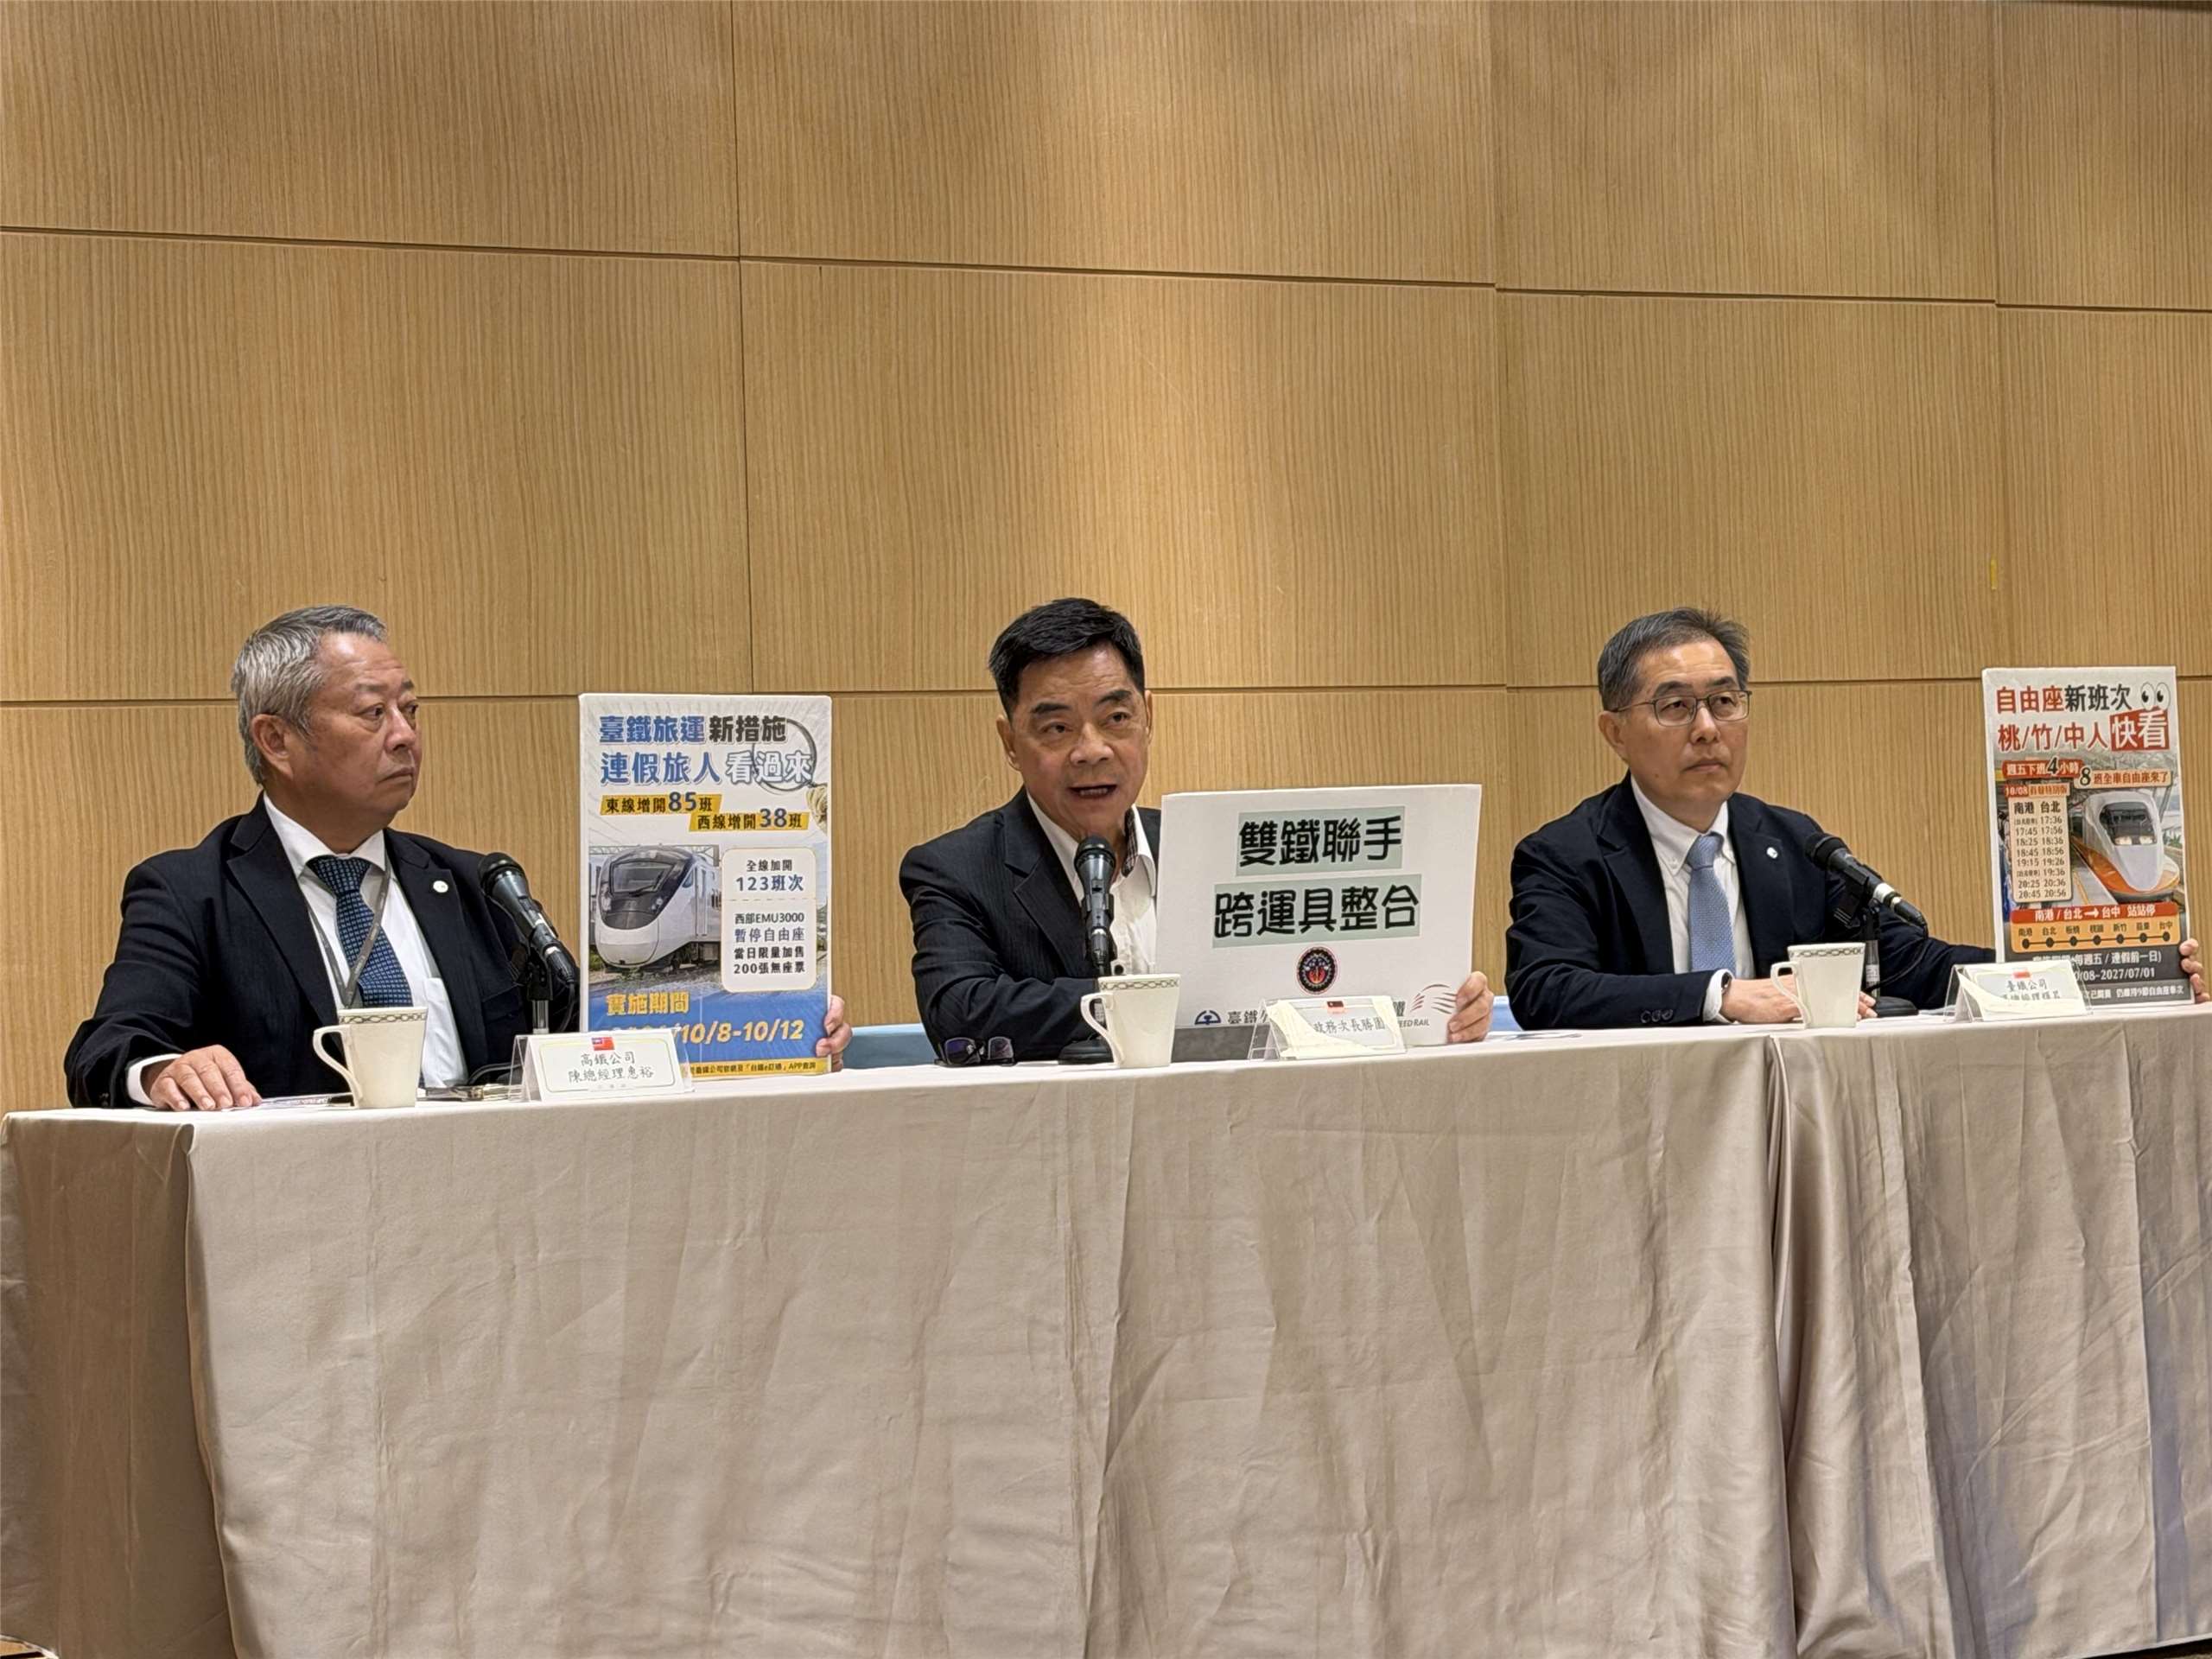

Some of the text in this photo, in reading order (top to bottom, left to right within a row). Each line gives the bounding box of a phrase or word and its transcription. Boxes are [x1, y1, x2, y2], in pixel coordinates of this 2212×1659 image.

[1997, 683, 2132, 714] 自由座新班次
[600, 750, 814, 785] 連假旅人看過來
[606, 791, 713, 813] 東線增開85班
[2040, 800, 2062, 813] 台北
[697, 809, 802, 830] 西線增開38班
[1239, 815, 1402, 868] 雙鐵聯手
[747, 859, 792, 873] 全線加開
[735, 874, 804, 892] 123班次
[734, 912, 805, 925] 西部EMU3000
[1214, 884, 1420, 938] 跨運具整合
[2063, 908, 2083, 920] 台北
[2101, 906, 2120, 918] 台中
[734, 926, 805, 943] 暫停自由座
[734, 945, 804, 960] 當日限量加售
[734, 961, 805, 975] 200張無座票
[606, 991, 690, 1016] 實施期間
[1414, 1018, 1430, 1027] RAIL
